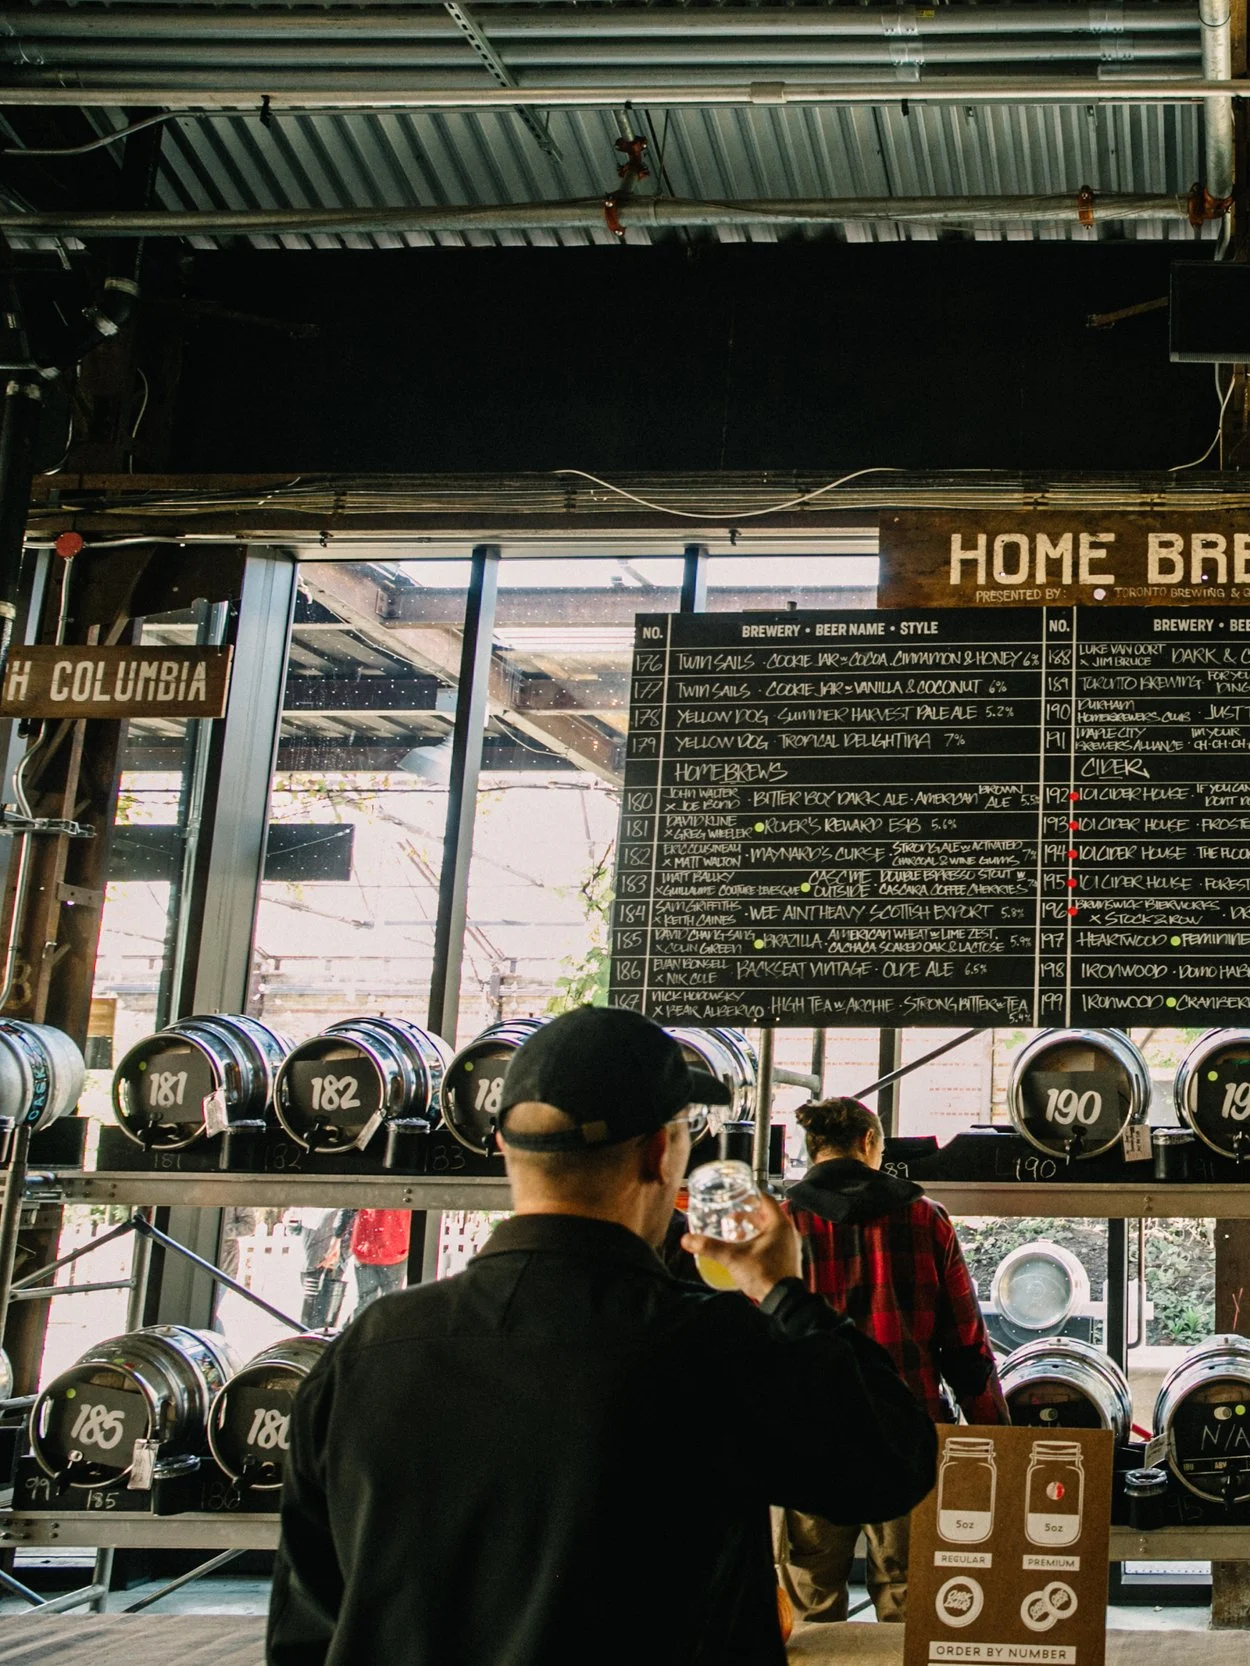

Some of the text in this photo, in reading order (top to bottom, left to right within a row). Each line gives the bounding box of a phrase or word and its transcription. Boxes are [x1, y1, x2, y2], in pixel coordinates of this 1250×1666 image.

[950, 533, 1115, 585] HOME
[976, 590, 1041, 602] PRESENTED
[1114, 587, 1167, 599] TORONTO
[1170, 587, 1225, 599] BREWING
[643, 622, 938, 639] NO. BREWERY BEER NAME STYLE
[1049, 620, 1070, 633] NO.
[1154, 619, 1214, 633] BREWERY
[635, 654, 663, 673] 176
[766, 654, 814, 669] COOKIE
[976, 650, 1022, 666] HONEY
[1048, 649, 1071, 666] 188
[1172, 648, 1217, 665] DARK
[2, 661, 206, 701] H COLUMBIA
[634, 681, 663, 700] 177
[766, 681, 813, 697] COOKIE
[854, 681, 903, 695] VANILLA
[917, 679, 982, 695] COCONUT
[988, 679, 1007, 694] 6%
[633, 705, 1014, 727] 178 YELLOW DOG SUMMER HARVEST 5.2%
[1045, 704, 1070, 721] 190
[632, 733, 965, 755] 179 YELLOW DOG TROPICAL 7%
[1047, 731, 1068, 750] 191
[627, 789, 977, 810] 180 BITTER DARK ALE AMERICAN
[1045, 787, 1069, 804] 192
[625, 818, 883, 838] 181 REWARD
[1042, 817, 1069, 835] 193
[622, 847, 886, 867] 182 CURSE
[1042, 875, 1067, 892] 195
[620, 904, 993, 922] 184 EXPORT
[1041, 902, 1068, 921] 196
[618, 932, 643, 950] 185
[1040, 932, 1167, 951] 197 HEARTWOOD
[616, 960, 954, 981] 186 BACKSEAT VINTAGE ALE
[1081, 964, 1168, 979] IRONWOOD
[1040, 993, 1064, 1015] 199
[1081, 994, 1167, 1010] IRONWOOD
[149, 1070, 188, 1107] 181
[311, 1074, 361, 1111] 182
[474, 1077, 504, 1113] 18
[1046, 1088, 1102, 1125] 190
[884, 1162, 908, 1178] 89
[1016, 1156, 1056, 1180] 190
[71, 1404, 125, 1450] 185
[1201, 1425, 1250, 1450] N/A
[87, 1492, 117, 1511] 185
[956, 1520, 974, 1529] 5oz
[1045, 1523, 1063, 1532] 5oz
[941, 1555, 985, 1564] REGULAR
[1028, 1559, 1075, 1567] PREMIUM
[936, 1646, 980, 1656] ORDER
[1008, 1649, 1066, 1659] NUMBER
